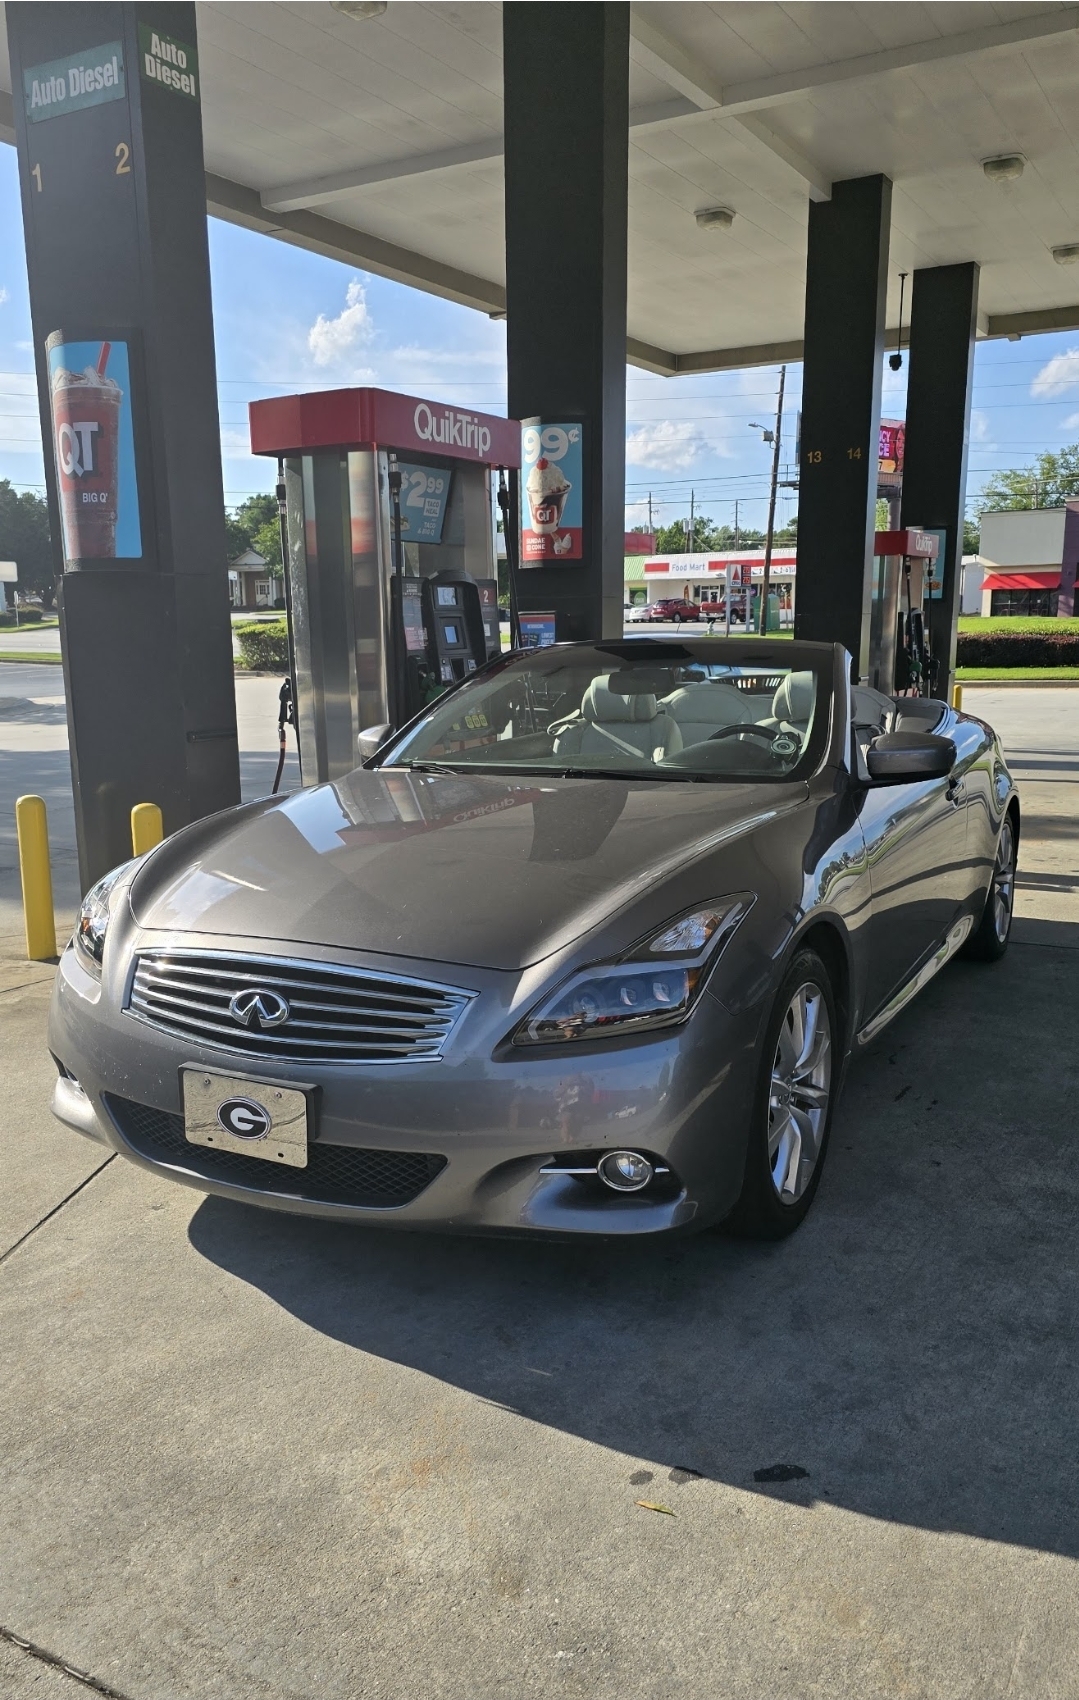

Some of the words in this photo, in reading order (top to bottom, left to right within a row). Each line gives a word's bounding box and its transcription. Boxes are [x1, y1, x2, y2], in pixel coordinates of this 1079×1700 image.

[151, 32, 187, 69] Auto
[31, 77, 66, 108] Auto
[68, 56, 119, 97] Diesel
[144, 53, 196, 97] Diesel
[115, 142, 131, 175] 2
[32, 163, 43, 192] 1
[414, 402, 491, 457] QuikTrip
[58, 421, 99, 478] QT
[807, 450, 822, 464] 13
[847, 447, 862, 460] 14
[82, 492, 98, 503] BIG
[427, 500, 440, 508] TACO
[536, 509, 552, 522] QT
[671, 563, 688, 572] Food
[689, 562, 706, 571] Mart
[483, 590, 489, 603] 2
[230, 1107, 267, 1131] G
